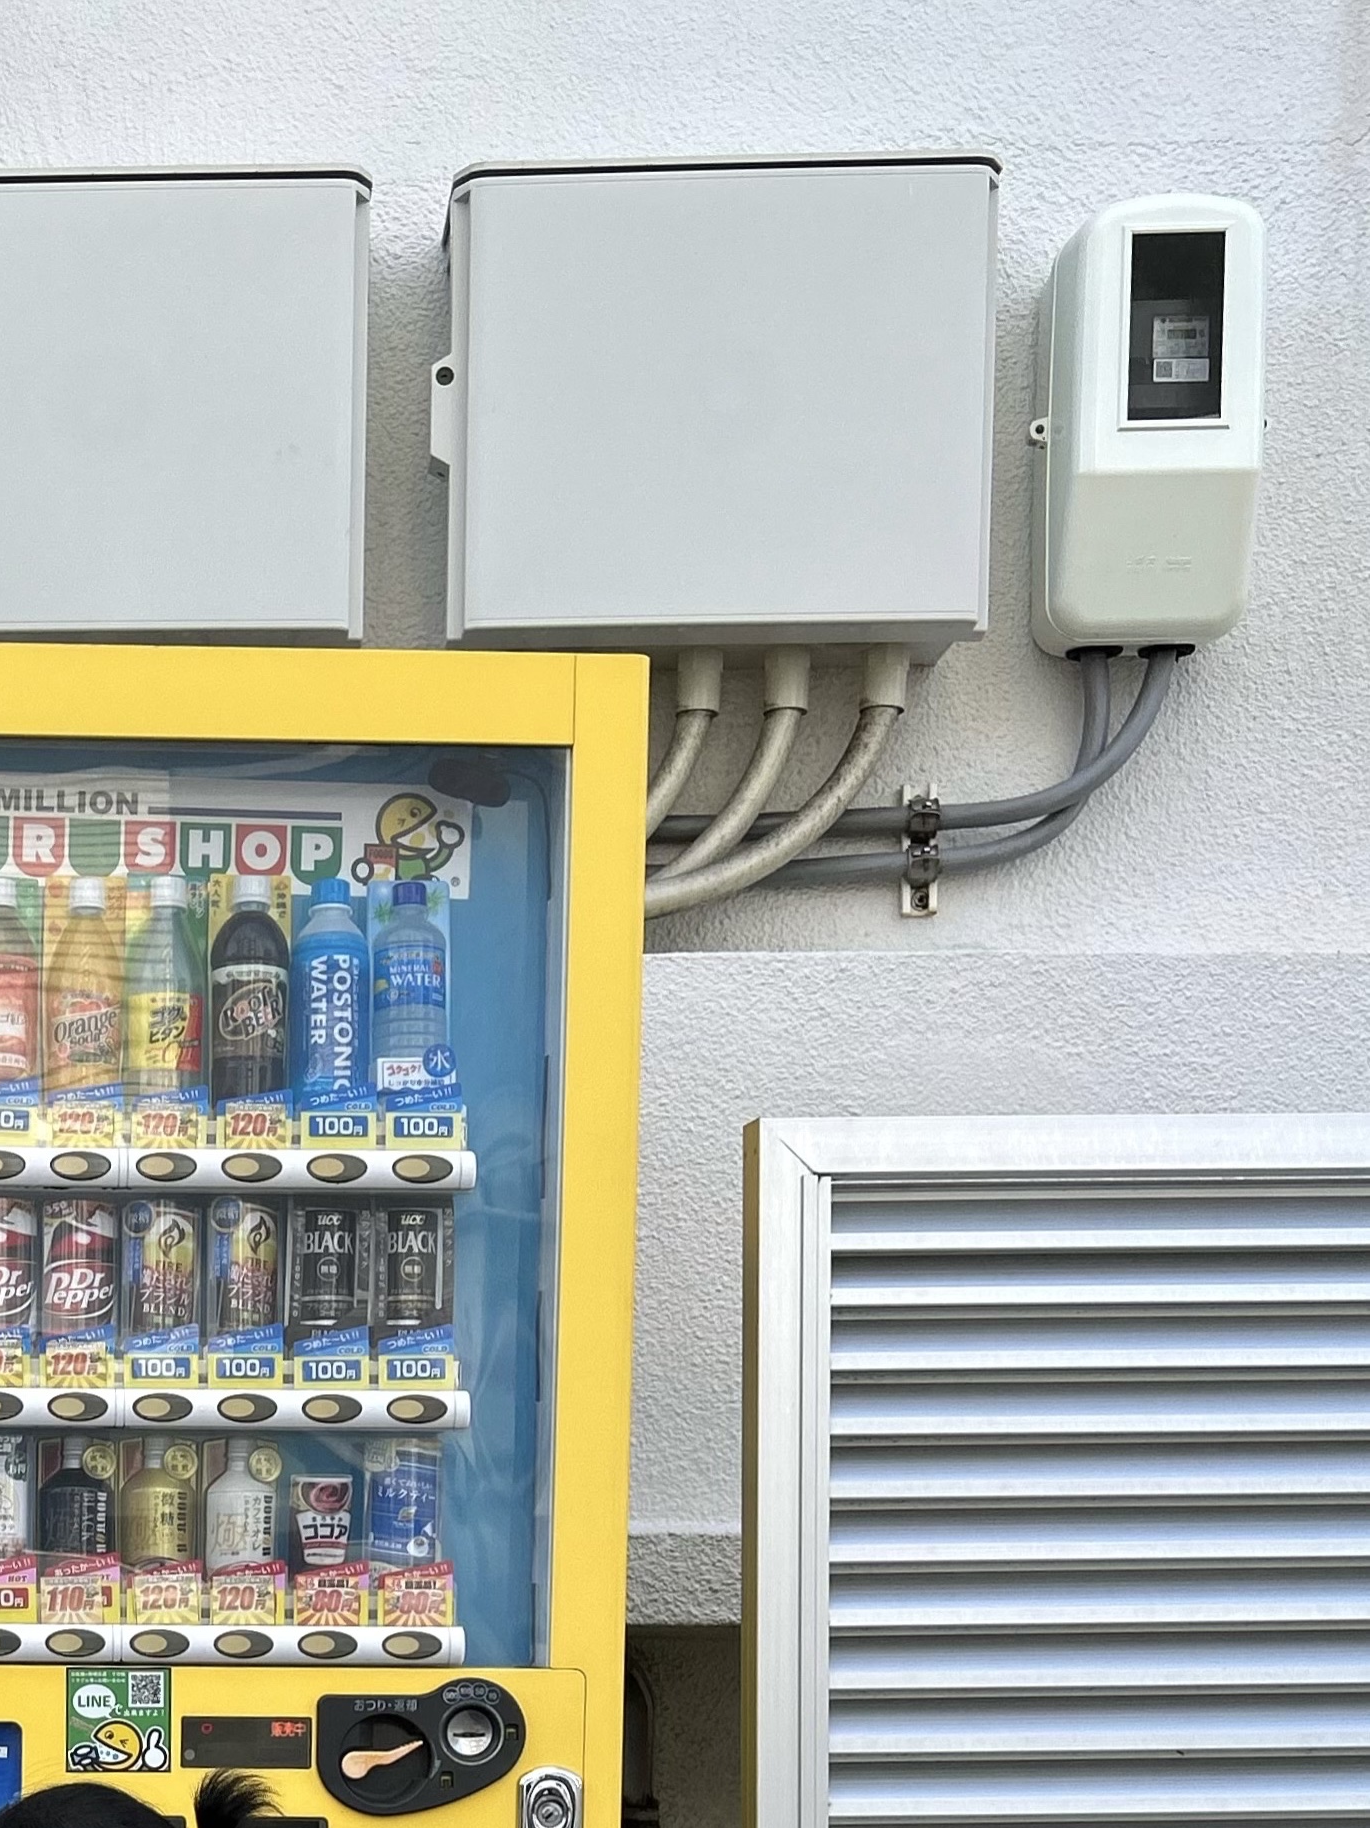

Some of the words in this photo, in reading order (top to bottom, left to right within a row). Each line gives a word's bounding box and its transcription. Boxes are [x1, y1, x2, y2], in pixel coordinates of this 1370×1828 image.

[134, 824, 335, 872] SHOP
[390, 965, 429, 974] MINERAL
[390, 973, 441, 988] WATER
[311, 955, 327, 1045] WATER
[53, 1006, 118, 1044] Orange
[429, 1049, 450, 1072] 水
[230, 1113, 279, 1137] 120円
[316, 1117, 363, 1136] 100円
[400, 1118, 448, 1136] 100円
[305, 1231, 353, 1254] BLACK
[388, 1231, 436, 1254] BLACK
[69, 1269, 105, 1288] Dr
[142, 1303, 186, 1317] BLEND
[230, 1299, 270, 1314] BLEND
[138, 1359, 185, 1377] 100円
[223, 1359, 270, 1377] 100円
[309, 1361, 356, 1379] 100円
[393, 1360, 441, 1378] 100円
[302, 1524, 348, 1540] ココア
[46, 1585, 96, 1612] 110円
[140, 1584, 190, 1611] 120円
[217, 1585, 266, 1611] 120円
[77, 1695, 111, 1708] LINE
[354, 1700, 417, 1712] おつり・返却
